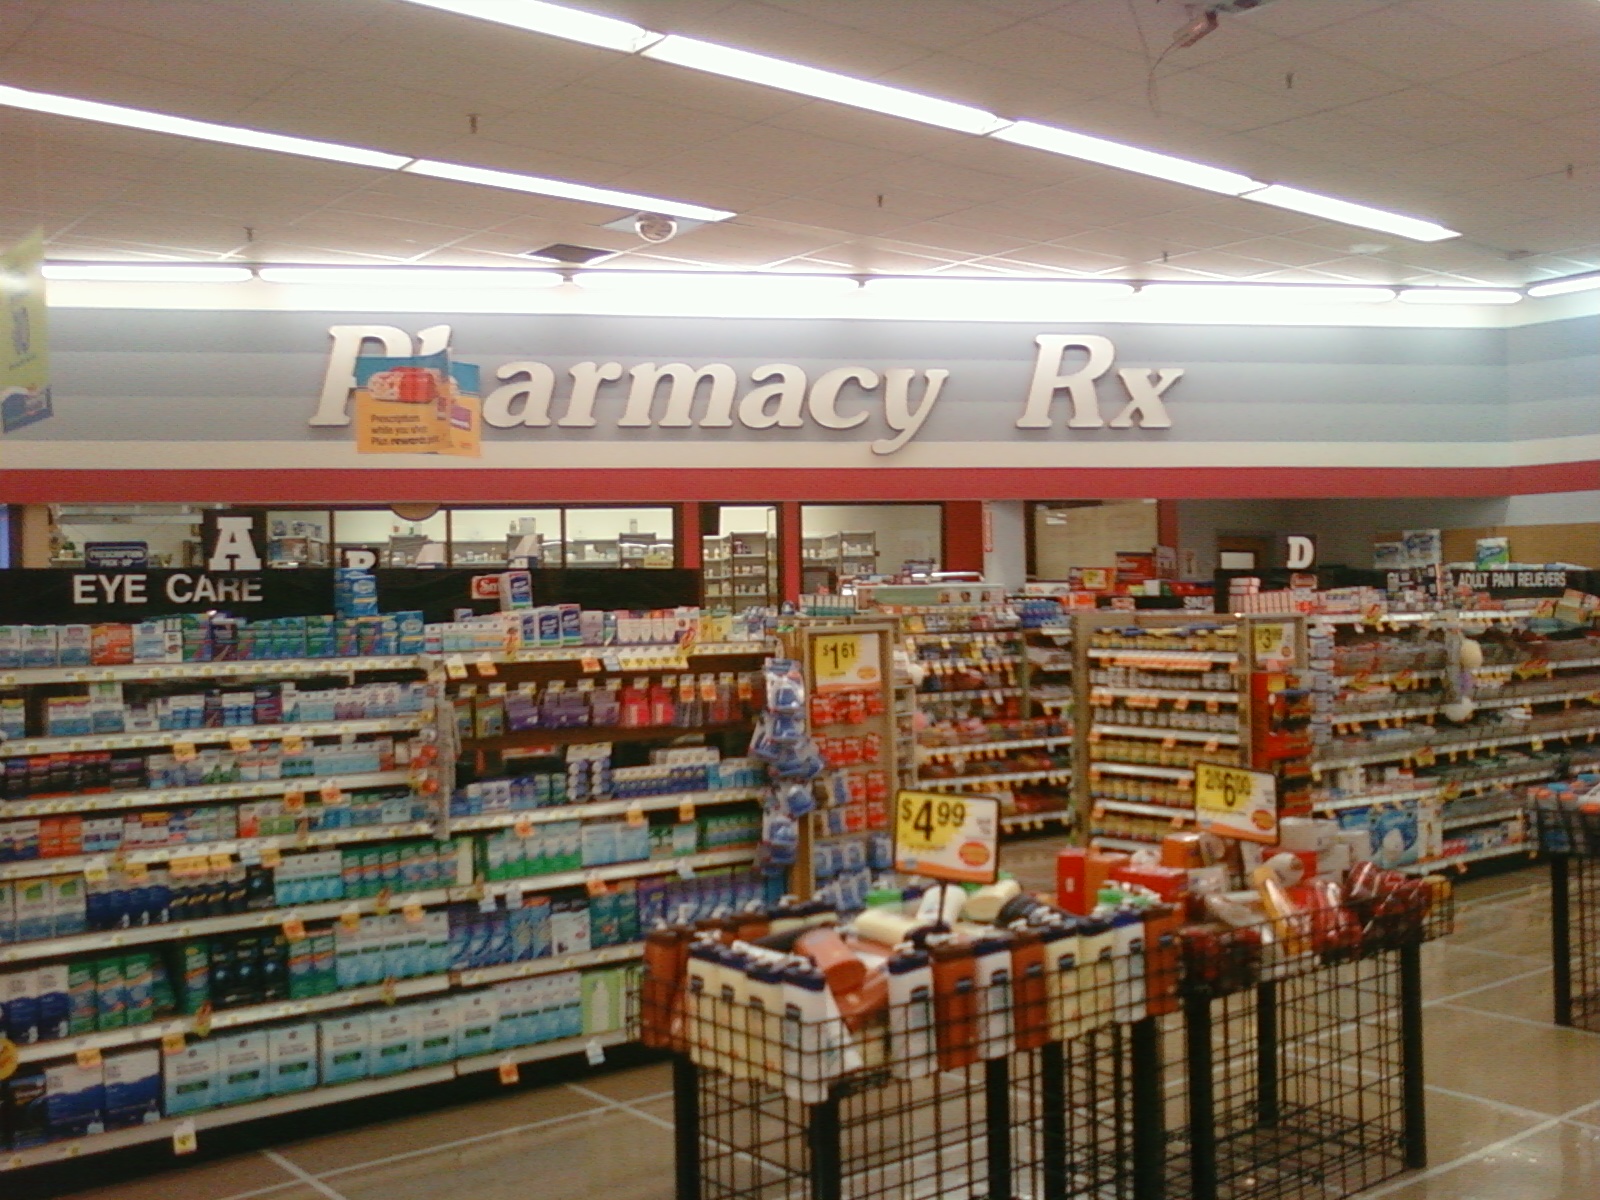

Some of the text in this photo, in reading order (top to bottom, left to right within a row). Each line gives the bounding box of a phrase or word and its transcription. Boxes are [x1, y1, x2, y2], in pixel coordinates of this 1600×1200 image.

[308, 324, 1185, 455] Parmacy Rx
[209, 516, 262, 571] A
[1287, 536, 1314, 569] D
[73, 573, 263, 604] EYE CARE
[1458, 571, 1566, 588] ADULT PAIN RELIEVERS
